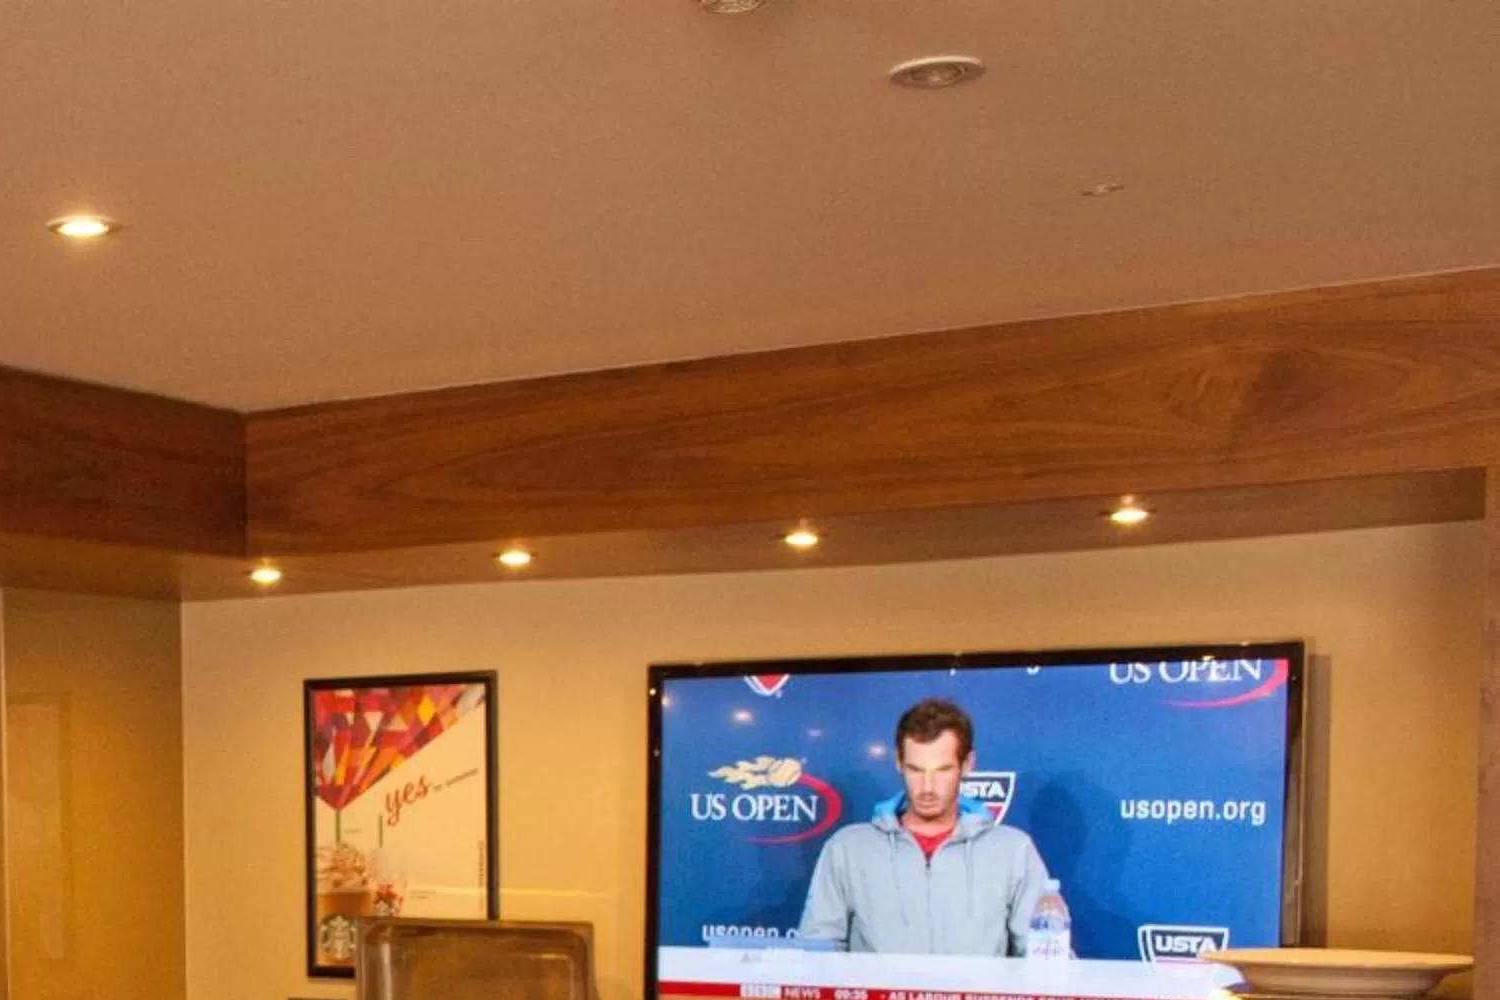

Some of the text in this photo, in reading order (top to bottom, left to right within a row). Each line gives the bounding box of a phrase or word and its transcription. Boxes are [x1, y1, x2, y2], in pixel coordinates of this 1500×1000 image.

[1109, 658, 1263, 684] US OPEN
[384, 773, 431, 828] yes
[960, 781, 1007, 799] STA
[690, 792, 820, 823] US OPEN
[1119, 799, 1267, 827] usopen.org
[1155, 934, 1218, 954] USTA
